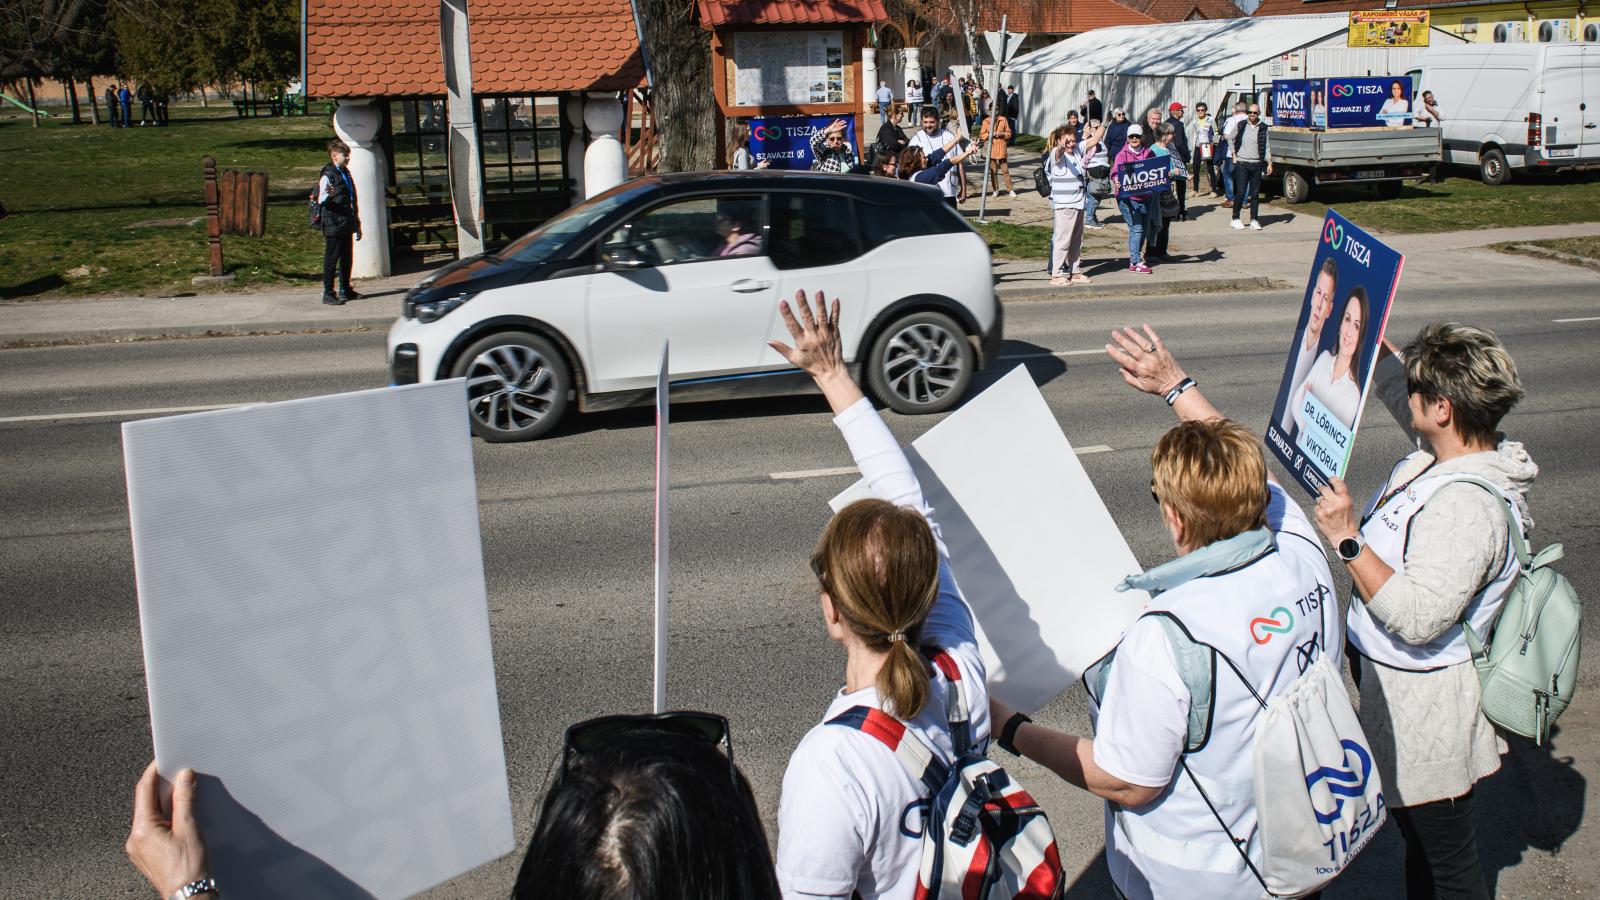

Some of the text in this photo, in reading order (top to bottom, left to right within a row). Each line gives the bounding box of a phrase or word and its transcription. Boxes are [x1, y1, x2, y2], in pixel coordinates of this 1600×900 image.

[1356, 85, 1383, 94] TISZA
[1277, 91, 1305, 109] MOST
[786, 125, 818, 137] TISZA
[756, 151, 794, 160] SZAVAZZ!
[1123, 166, 1166, 185] MOST
[1344, 235, 1371, 268] TISZA
[1304, 401, 1347, 448] DR. LŐRINCZ
[1268, 426, 1294, 460] SZAVAZZ!
[1306, 435, 1338, 475] VIKTÓRIA
